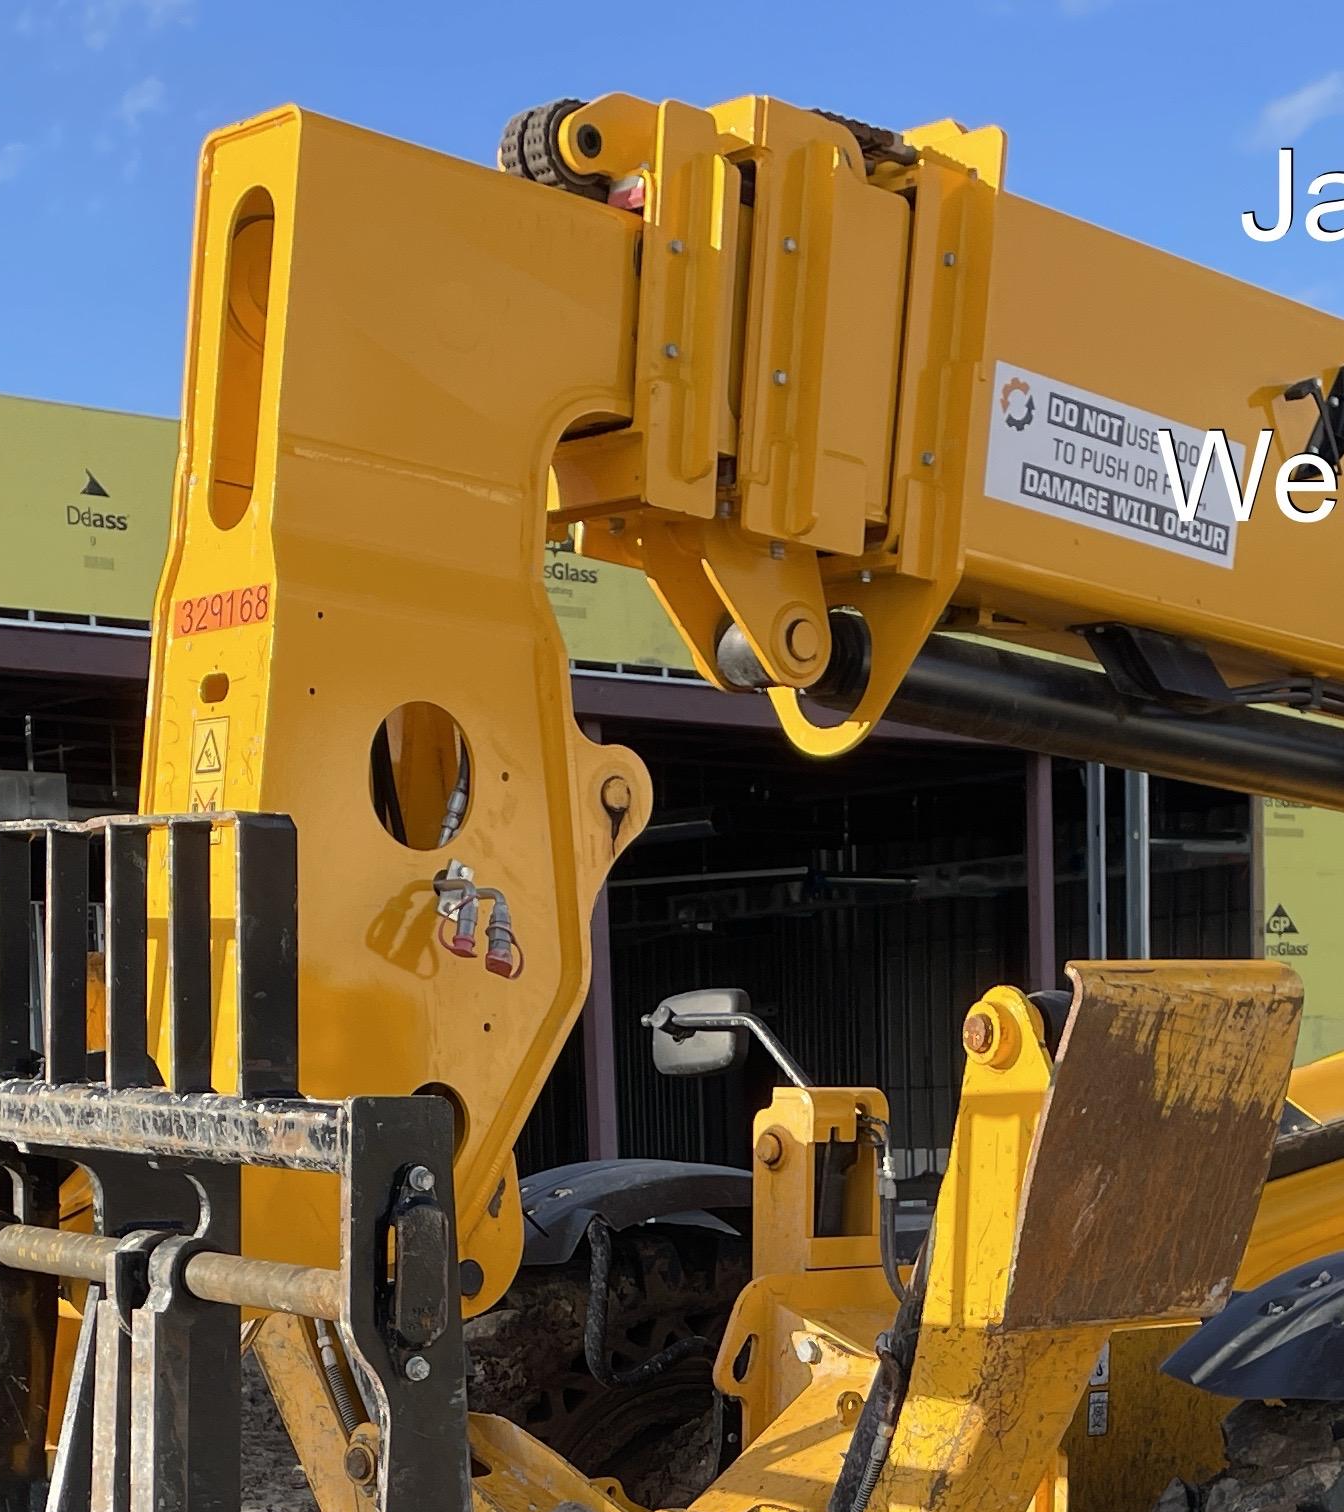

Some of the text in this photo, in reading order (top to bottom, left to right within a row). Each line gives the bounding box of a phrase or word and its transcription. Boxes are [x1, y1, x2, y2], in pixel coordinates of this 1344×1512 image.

[1049, 397, 1079, 427] DO
[1082, 406, 1123, 442] NOT
[1126, 421, 1160, 455] USE
[1053, 437, 1158, 491] TO PUSH OR
[1023, 466, 1228, 552] DAMAGE WILL OCCUR
[181, 584, 269, 634] 329168
[1269, 916, 1291, 932] GP
